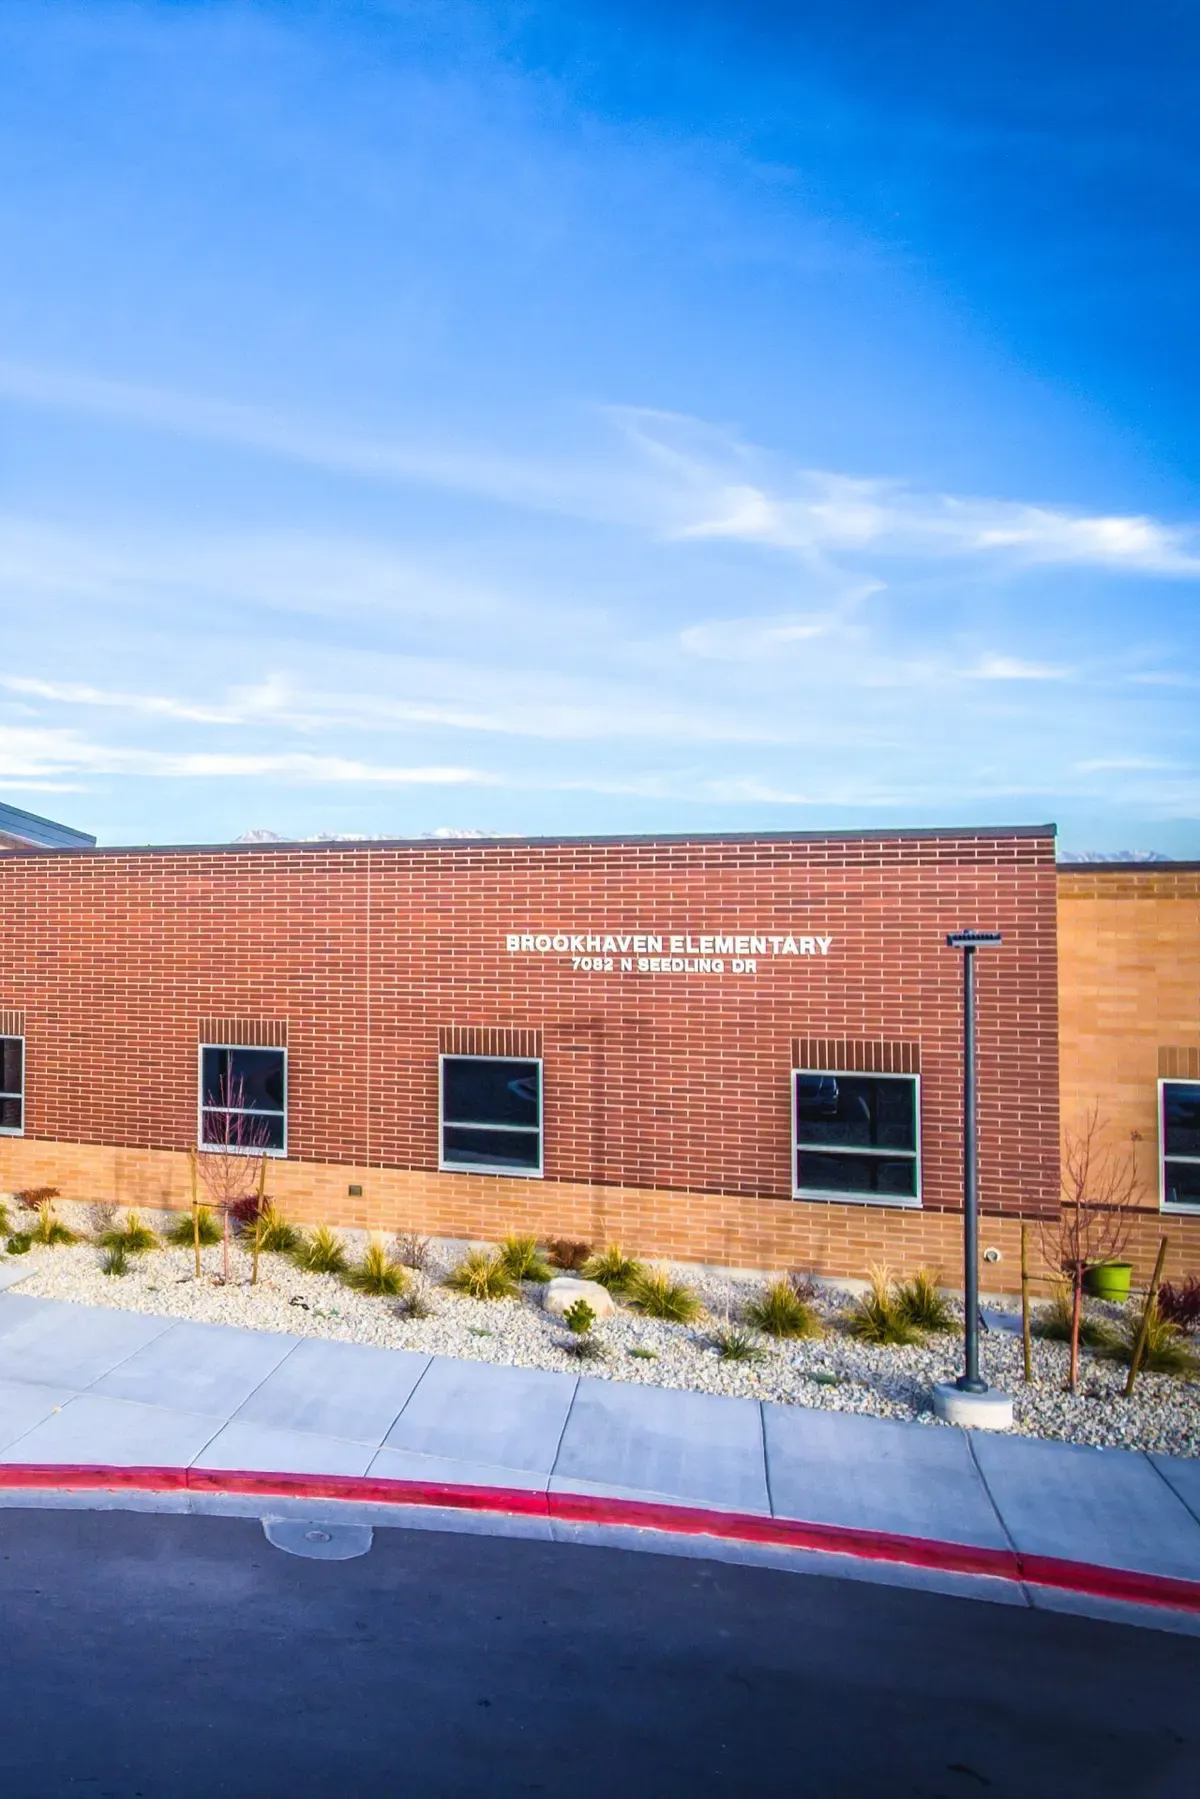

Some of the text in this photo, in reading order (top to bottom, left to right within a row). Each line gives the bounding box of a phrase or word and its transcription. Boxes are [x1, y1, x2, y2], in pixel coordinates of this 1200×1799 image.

[505, 934, 833, 955] BROOKHAVEN ELEMENTARY
[572, 957, 757, 973] 7082 N SEEDLING DR
